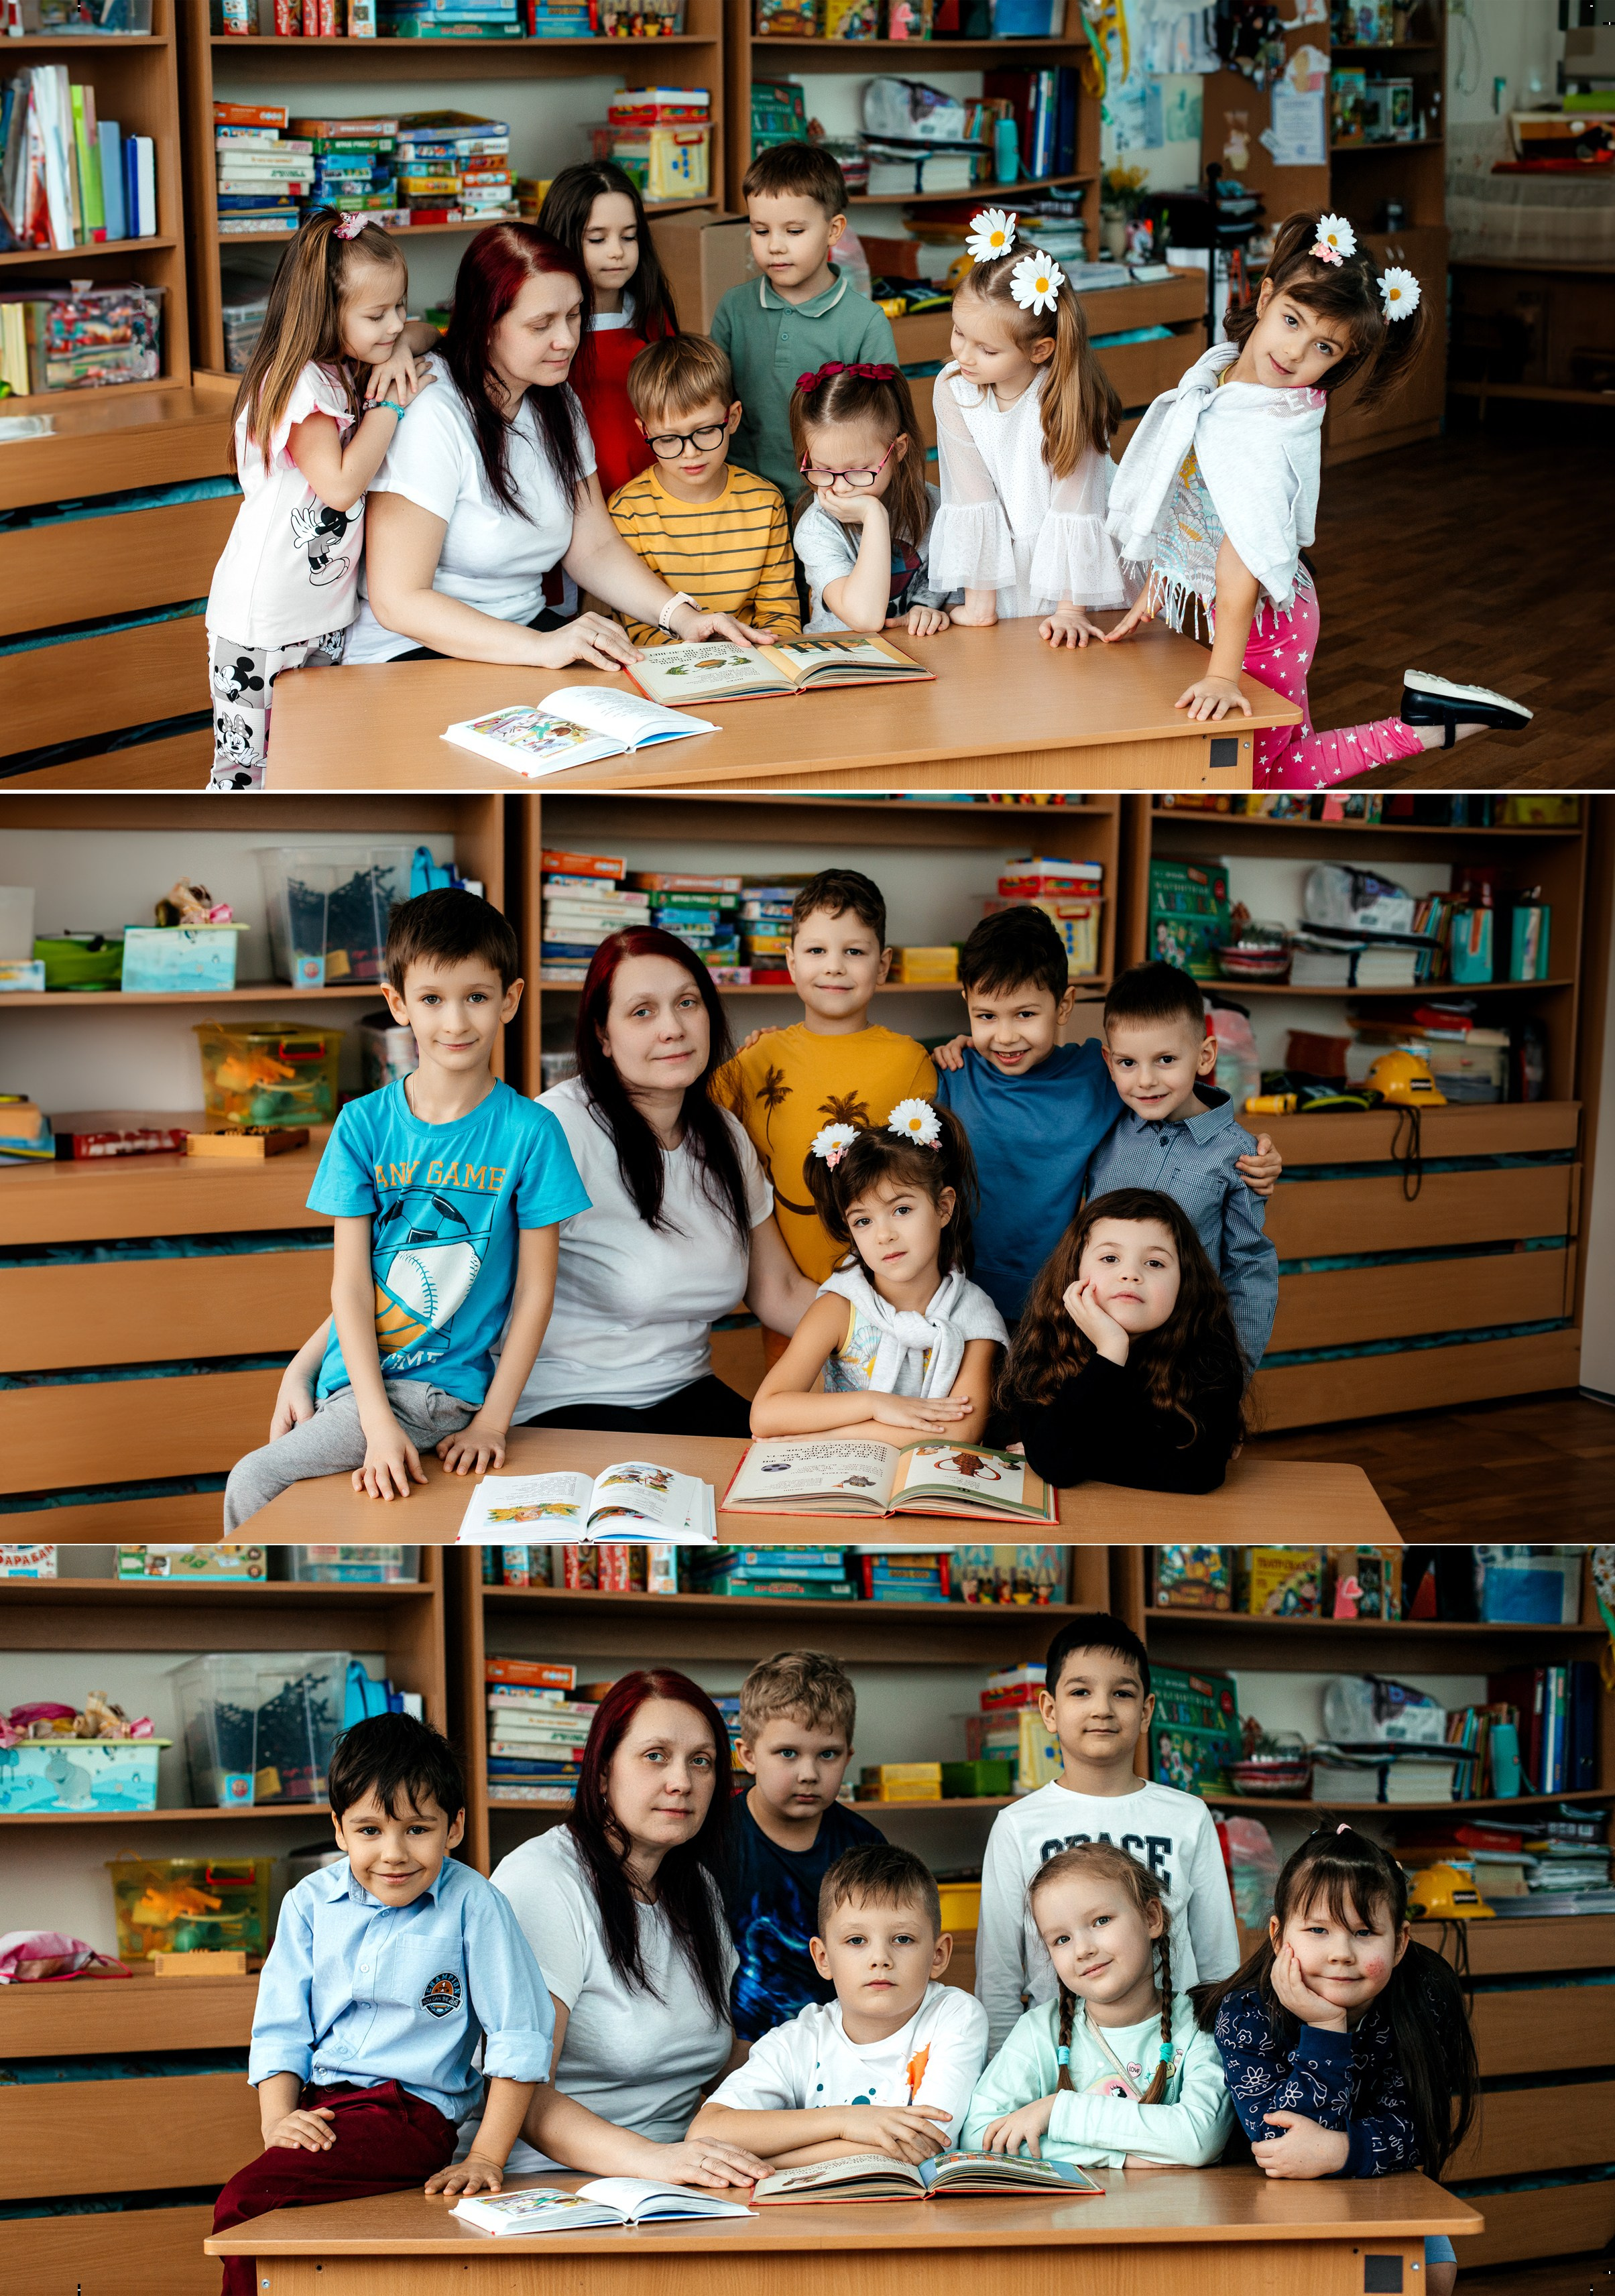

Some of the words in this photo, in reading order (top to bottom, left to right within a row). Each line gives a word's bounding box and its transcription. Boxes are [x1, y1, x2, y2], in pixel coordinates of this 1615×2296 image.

[1156, 892, 1217, 916] АЗБУКА
[374, 1160, 420, 1189] ANY
[427, 1160, 506, 1191] GAME
[1157, 1701, 1226, 1730] АЗБУКА
[426, 1974, 461, 1994] CHAMPION
